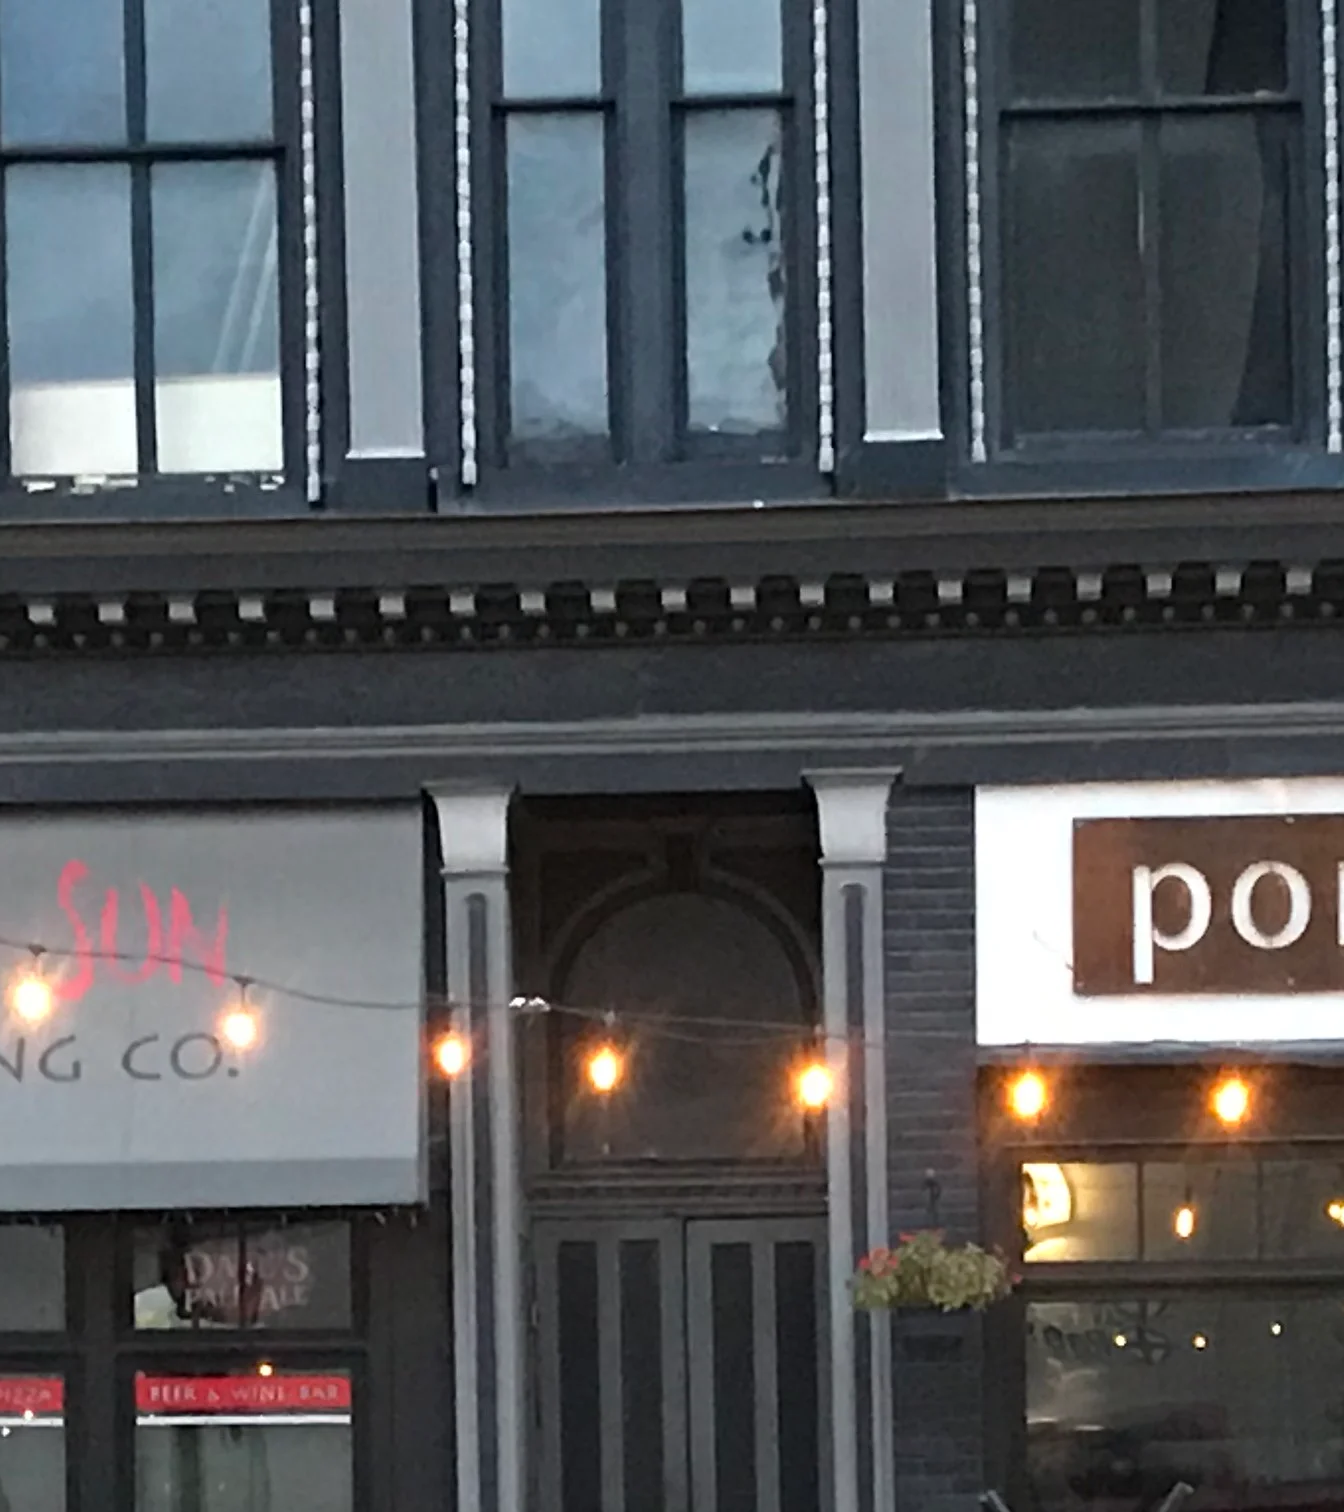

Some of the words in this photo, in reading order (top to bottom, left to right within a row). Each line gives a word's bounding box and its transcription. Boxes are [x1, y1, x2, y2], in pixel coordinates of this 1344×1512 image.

[121, 1032, 241, 1080] CO.
[149, 1385, 196, 1402] BEER
[230, 1385, 284, 1402] WINE
[299, 1384, 339, 1401] BAR
